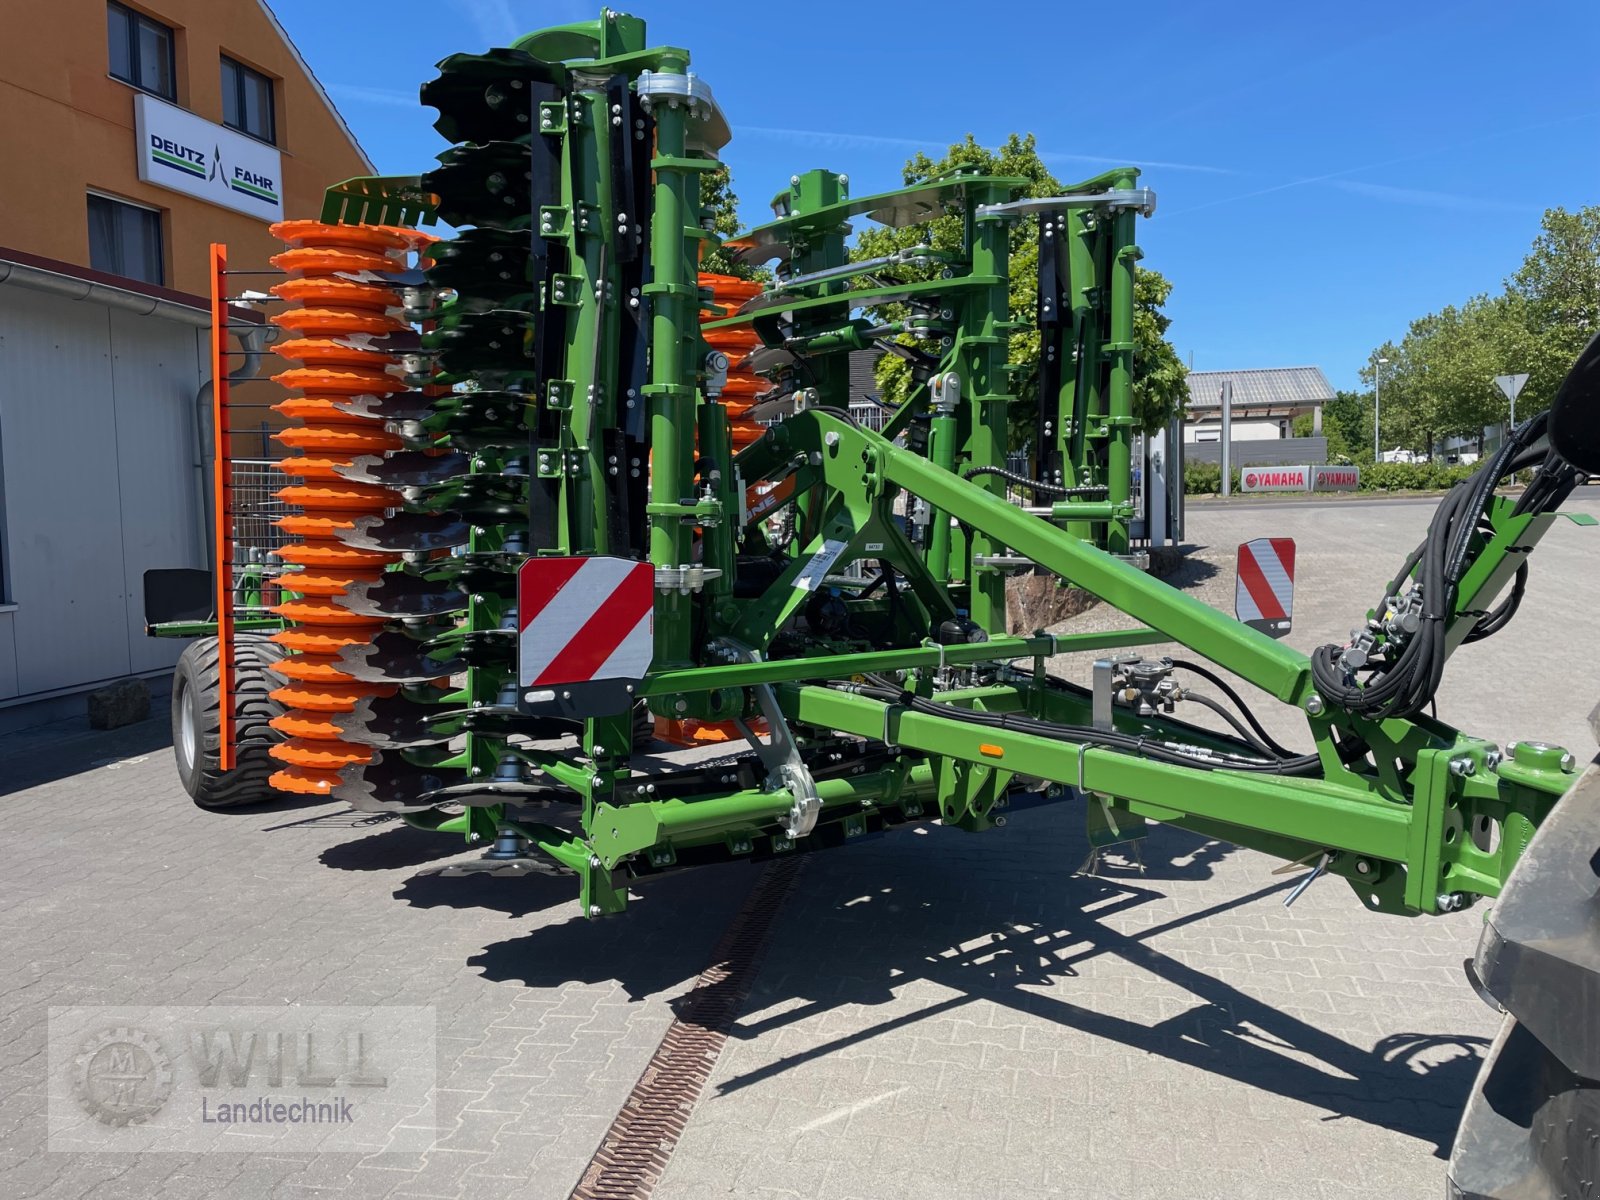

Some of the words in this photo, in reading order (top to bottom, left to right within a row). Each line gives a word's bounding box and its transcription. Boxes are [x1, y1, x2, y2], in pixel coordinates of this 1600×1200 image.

[151, 134, 205, 166] DEUTZ
[235, 166, 273, 191] FAHR
[1258, 472, 1304, 486] YAMAHA
[1325, 472, 1357, 485] YAMAHA
